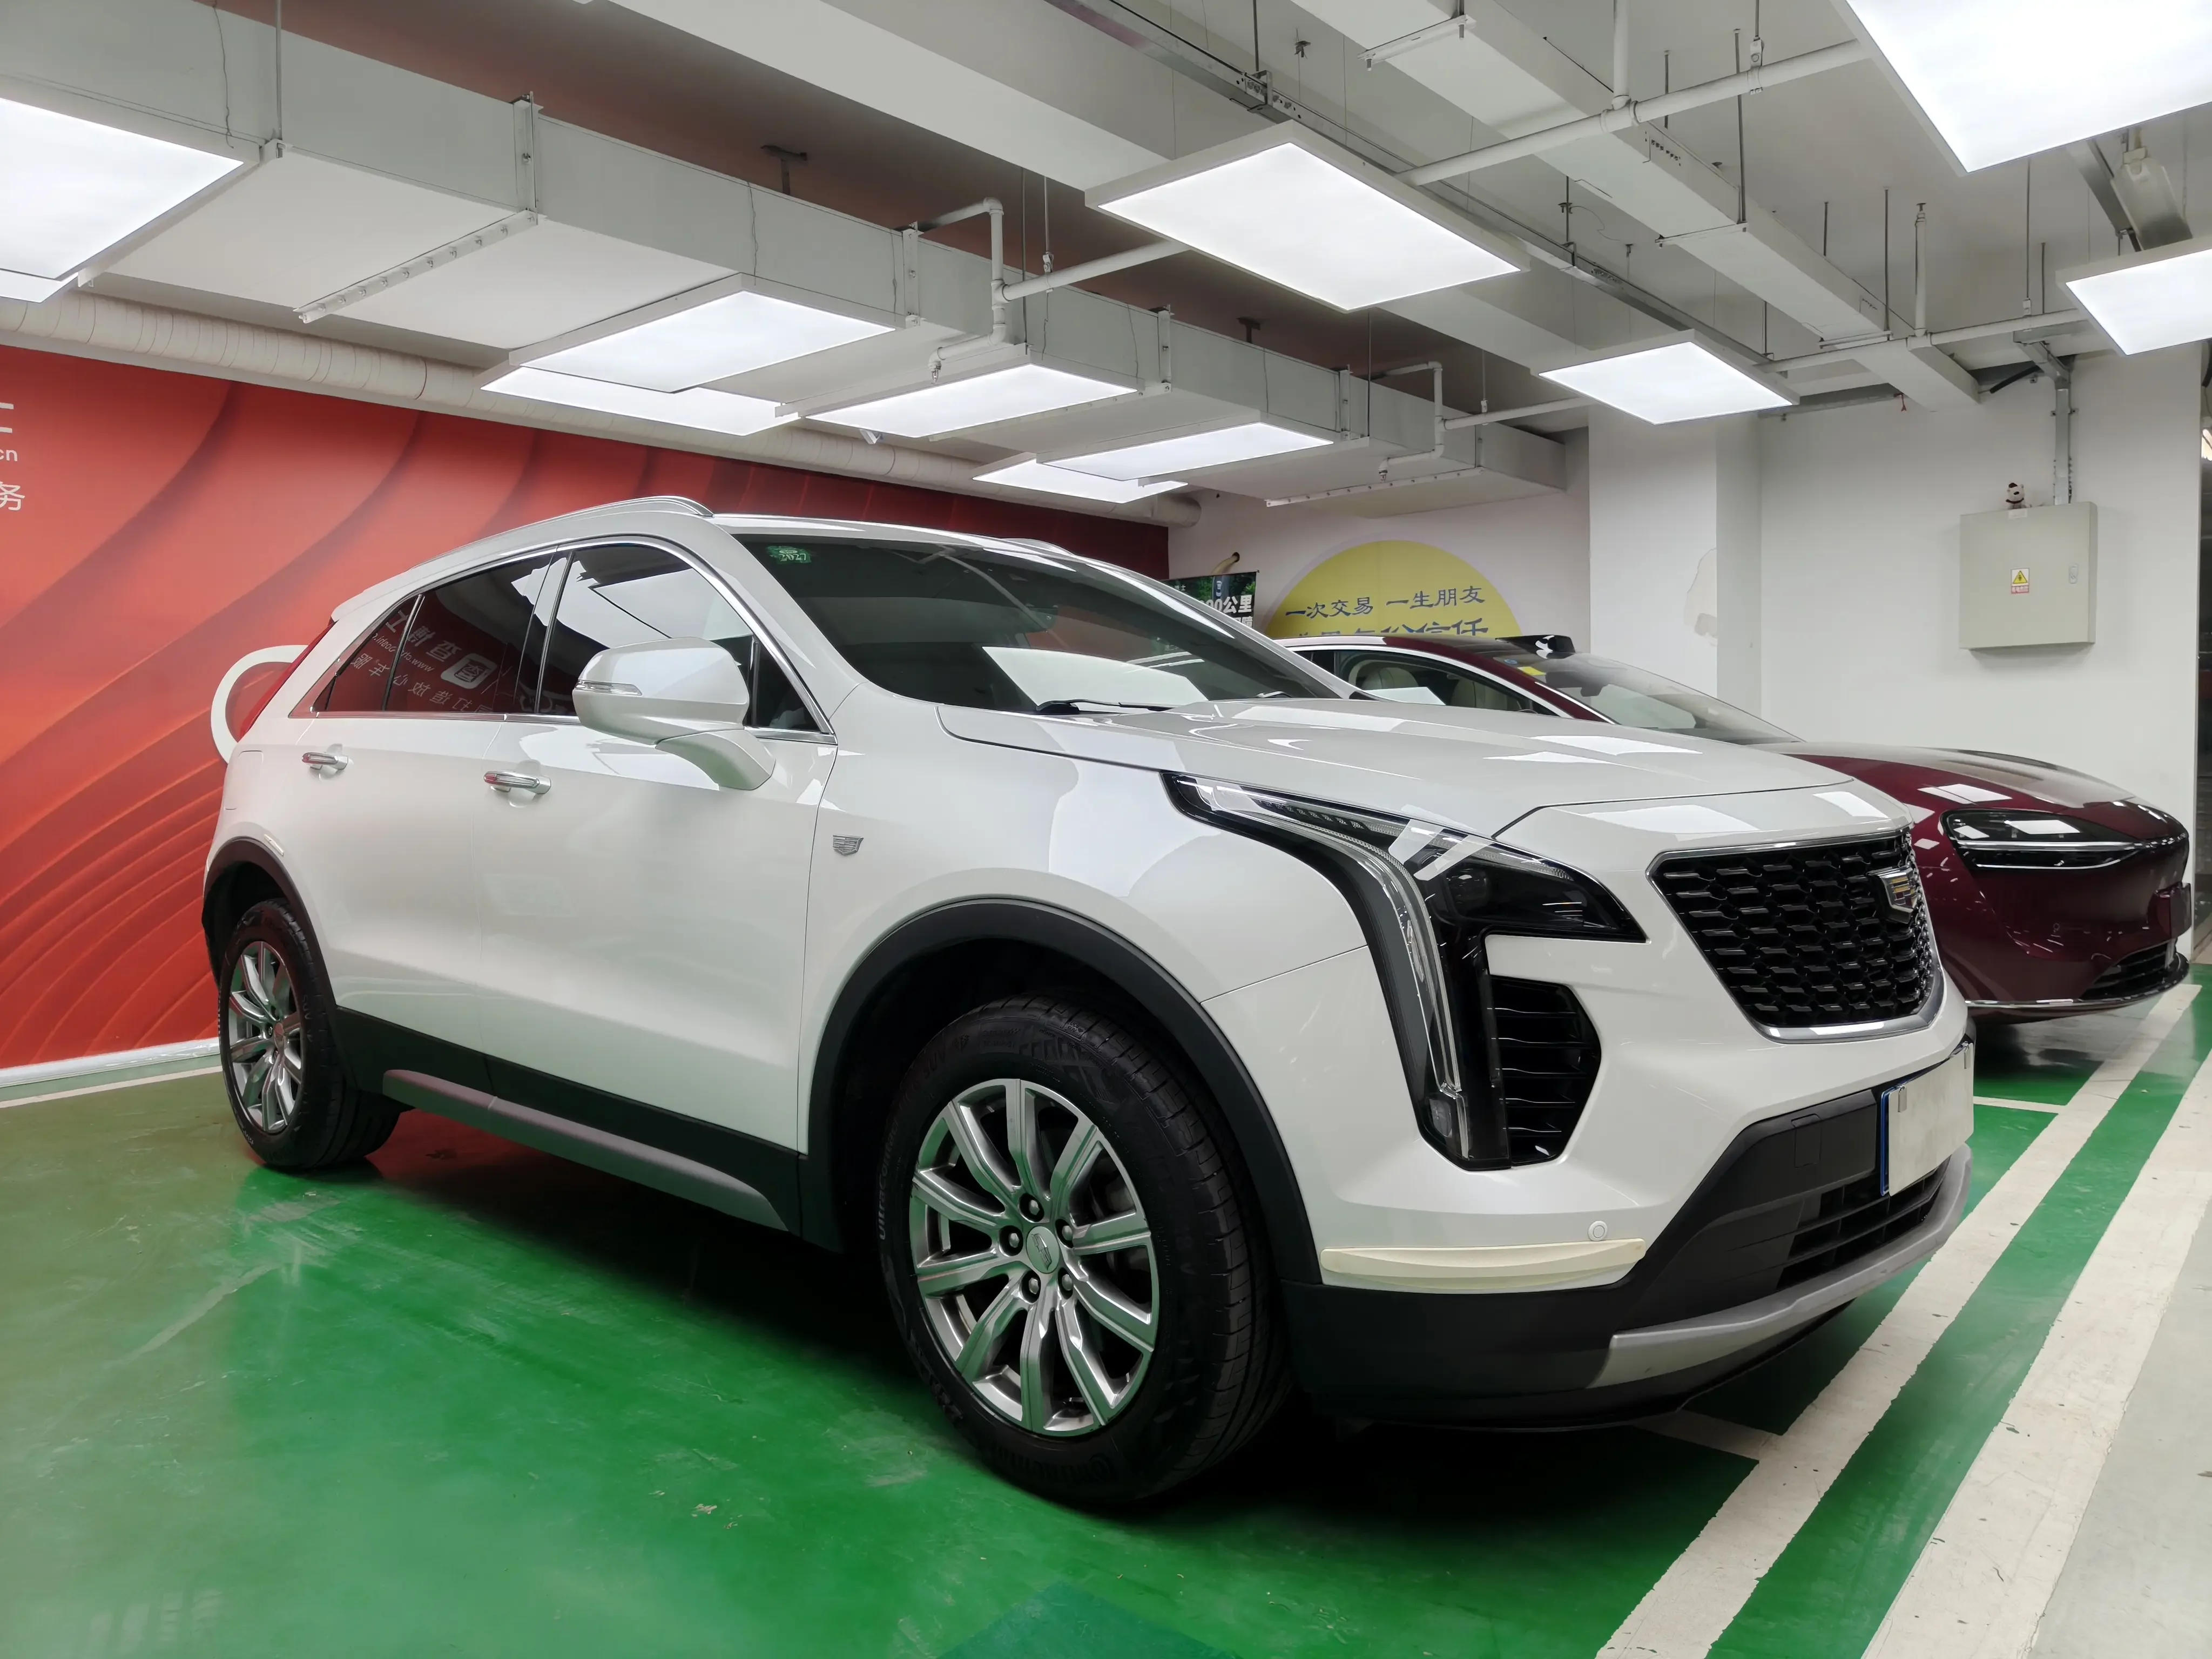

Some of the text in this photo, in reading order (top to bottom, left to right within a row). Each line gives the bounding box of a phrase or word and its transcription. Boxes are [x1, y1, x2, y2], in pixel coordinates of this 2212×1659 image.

[1285, 585, 1486, 619] 一次交易 一生朋友
